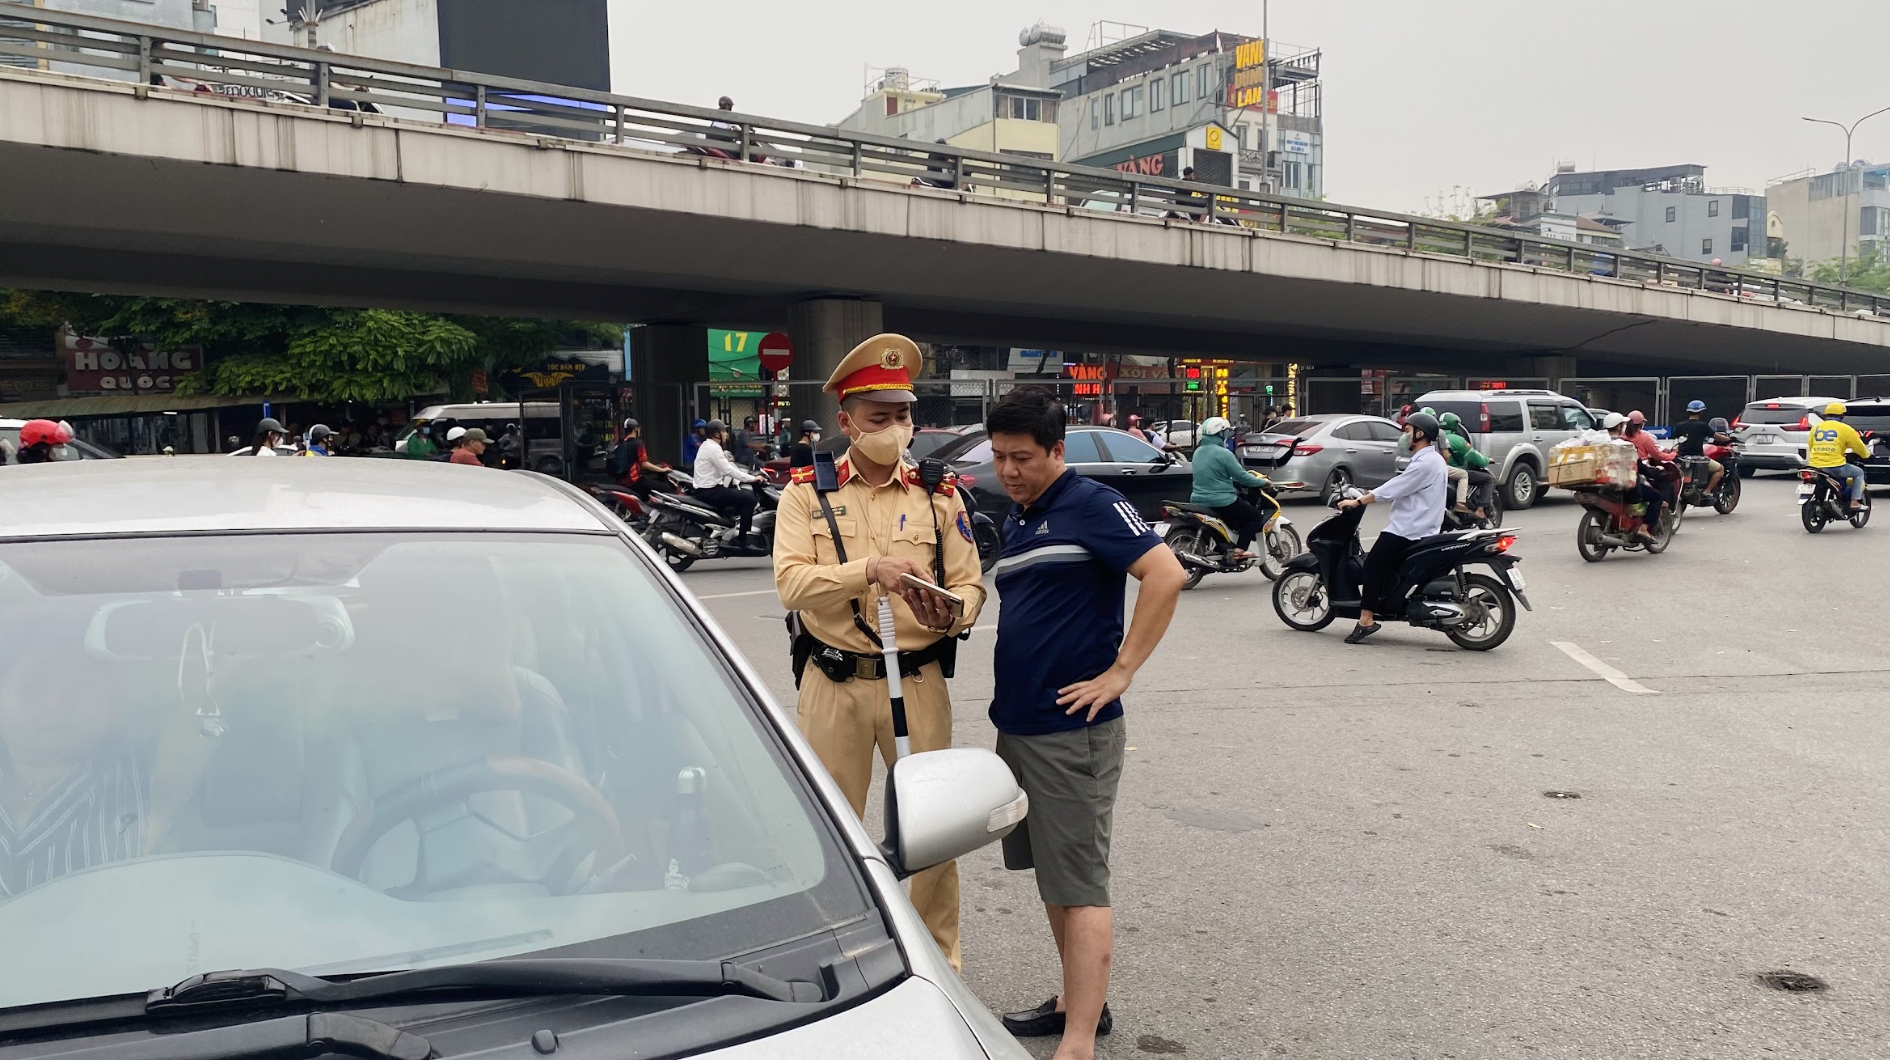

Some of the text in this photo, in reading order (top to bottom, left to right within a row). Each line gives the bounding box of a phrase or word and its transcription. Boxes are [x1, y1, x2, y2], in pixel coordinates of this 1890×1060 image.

[1237, 86, 1262, 108] LAN
[724, 332, 748, 352] 17
[1120, 367, 1147, 378] XÔI
[1814, 426, 1838, 442] be
